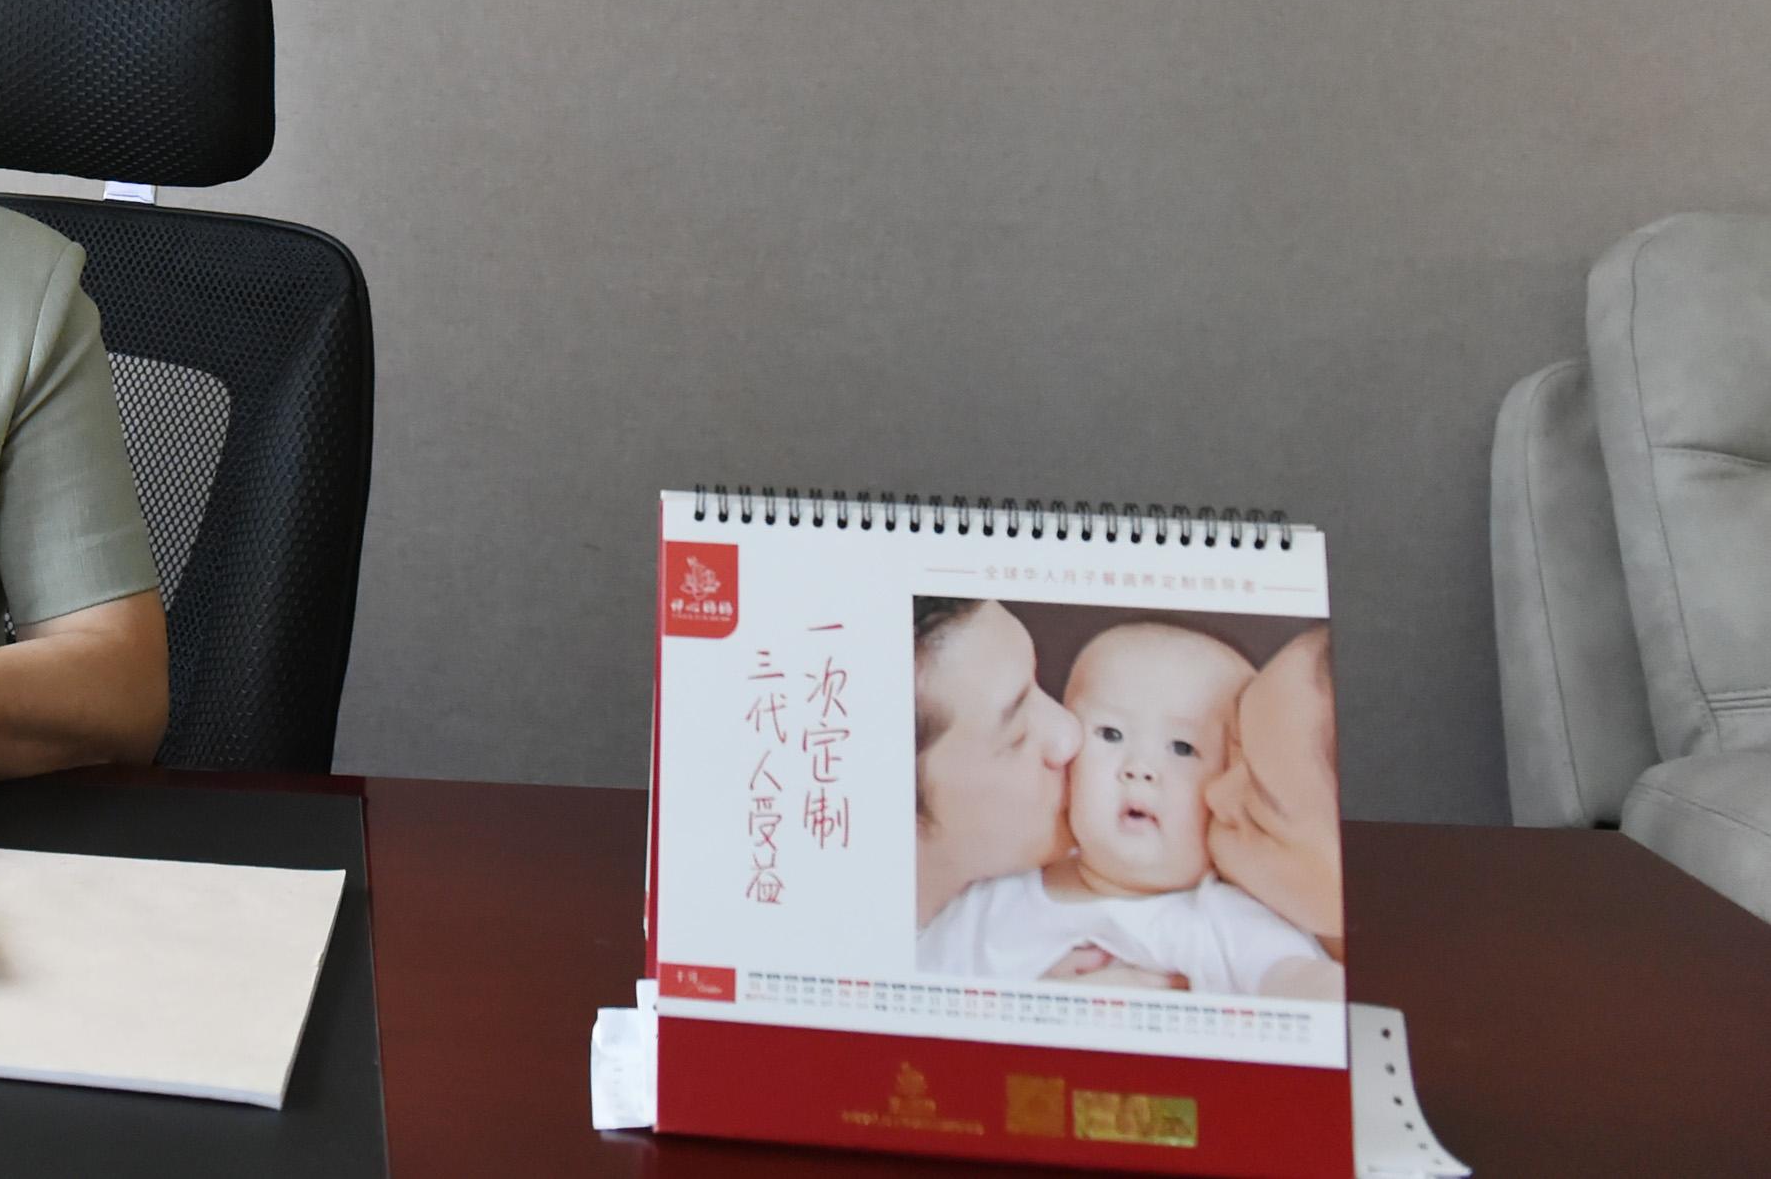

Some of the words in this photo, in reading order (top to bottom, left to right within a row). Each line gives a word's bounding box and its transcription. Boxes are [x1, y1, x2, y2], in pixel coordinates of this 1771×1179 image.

[745, 650, 787, 905] 三代人受益
[803, 623, 850, 850] 一次定制
